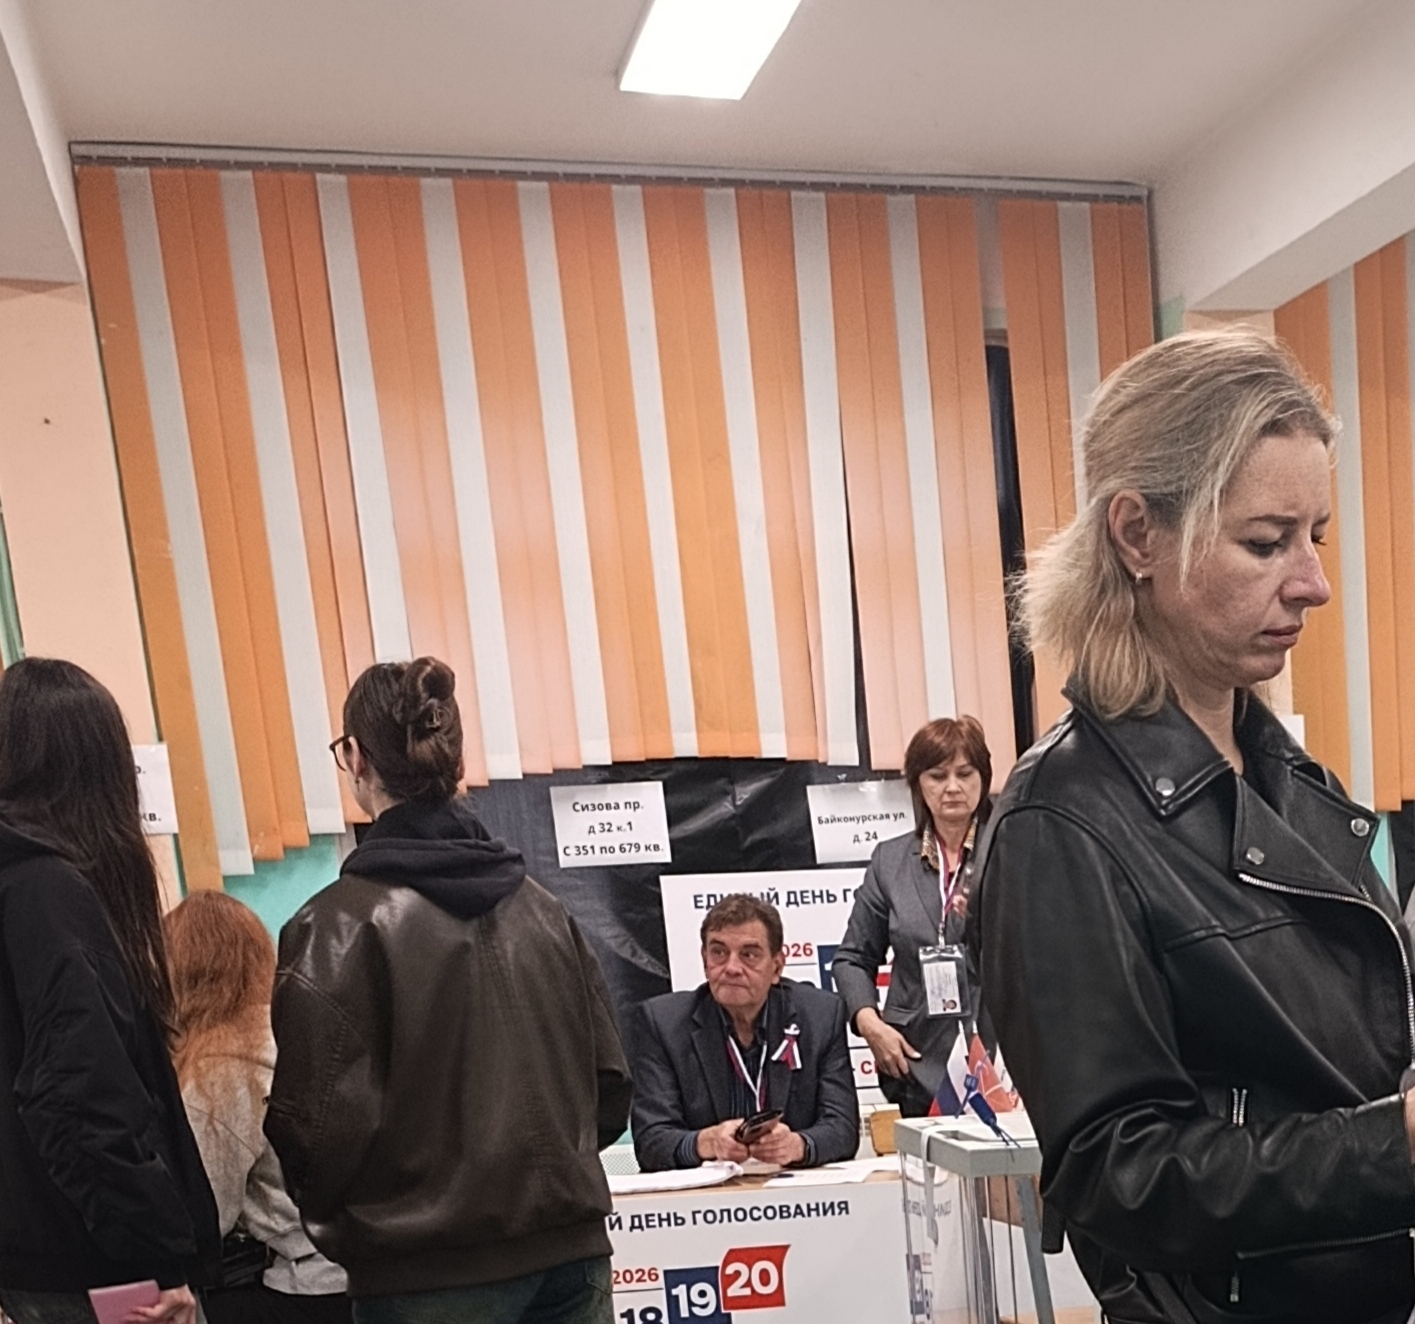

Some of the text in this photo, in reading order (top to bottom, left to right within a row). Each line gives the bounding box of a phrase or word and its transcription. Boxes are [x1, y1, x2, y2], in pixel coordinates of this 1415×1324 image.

[572, 800, 644, 812] Сизова пр.
[817, 812, 890, 825] Байконурская
[598, 822, 613, 833] 32
[865, 831, 878, 842] 24
[563, 842, 664, 856] С 351 по 679 кв.
[786, 889, 837, 908] ДЕНЬ
[629, 1211, 686, 1233] ДЕНЬ
[691, 1200, 850, 1225] ГОЛОСОВАНИЯ
[612, 1267, 659, 1285] 2026
[671, 1281, 718, 1319] 19
[724, 1259, 779, 1298] 20
